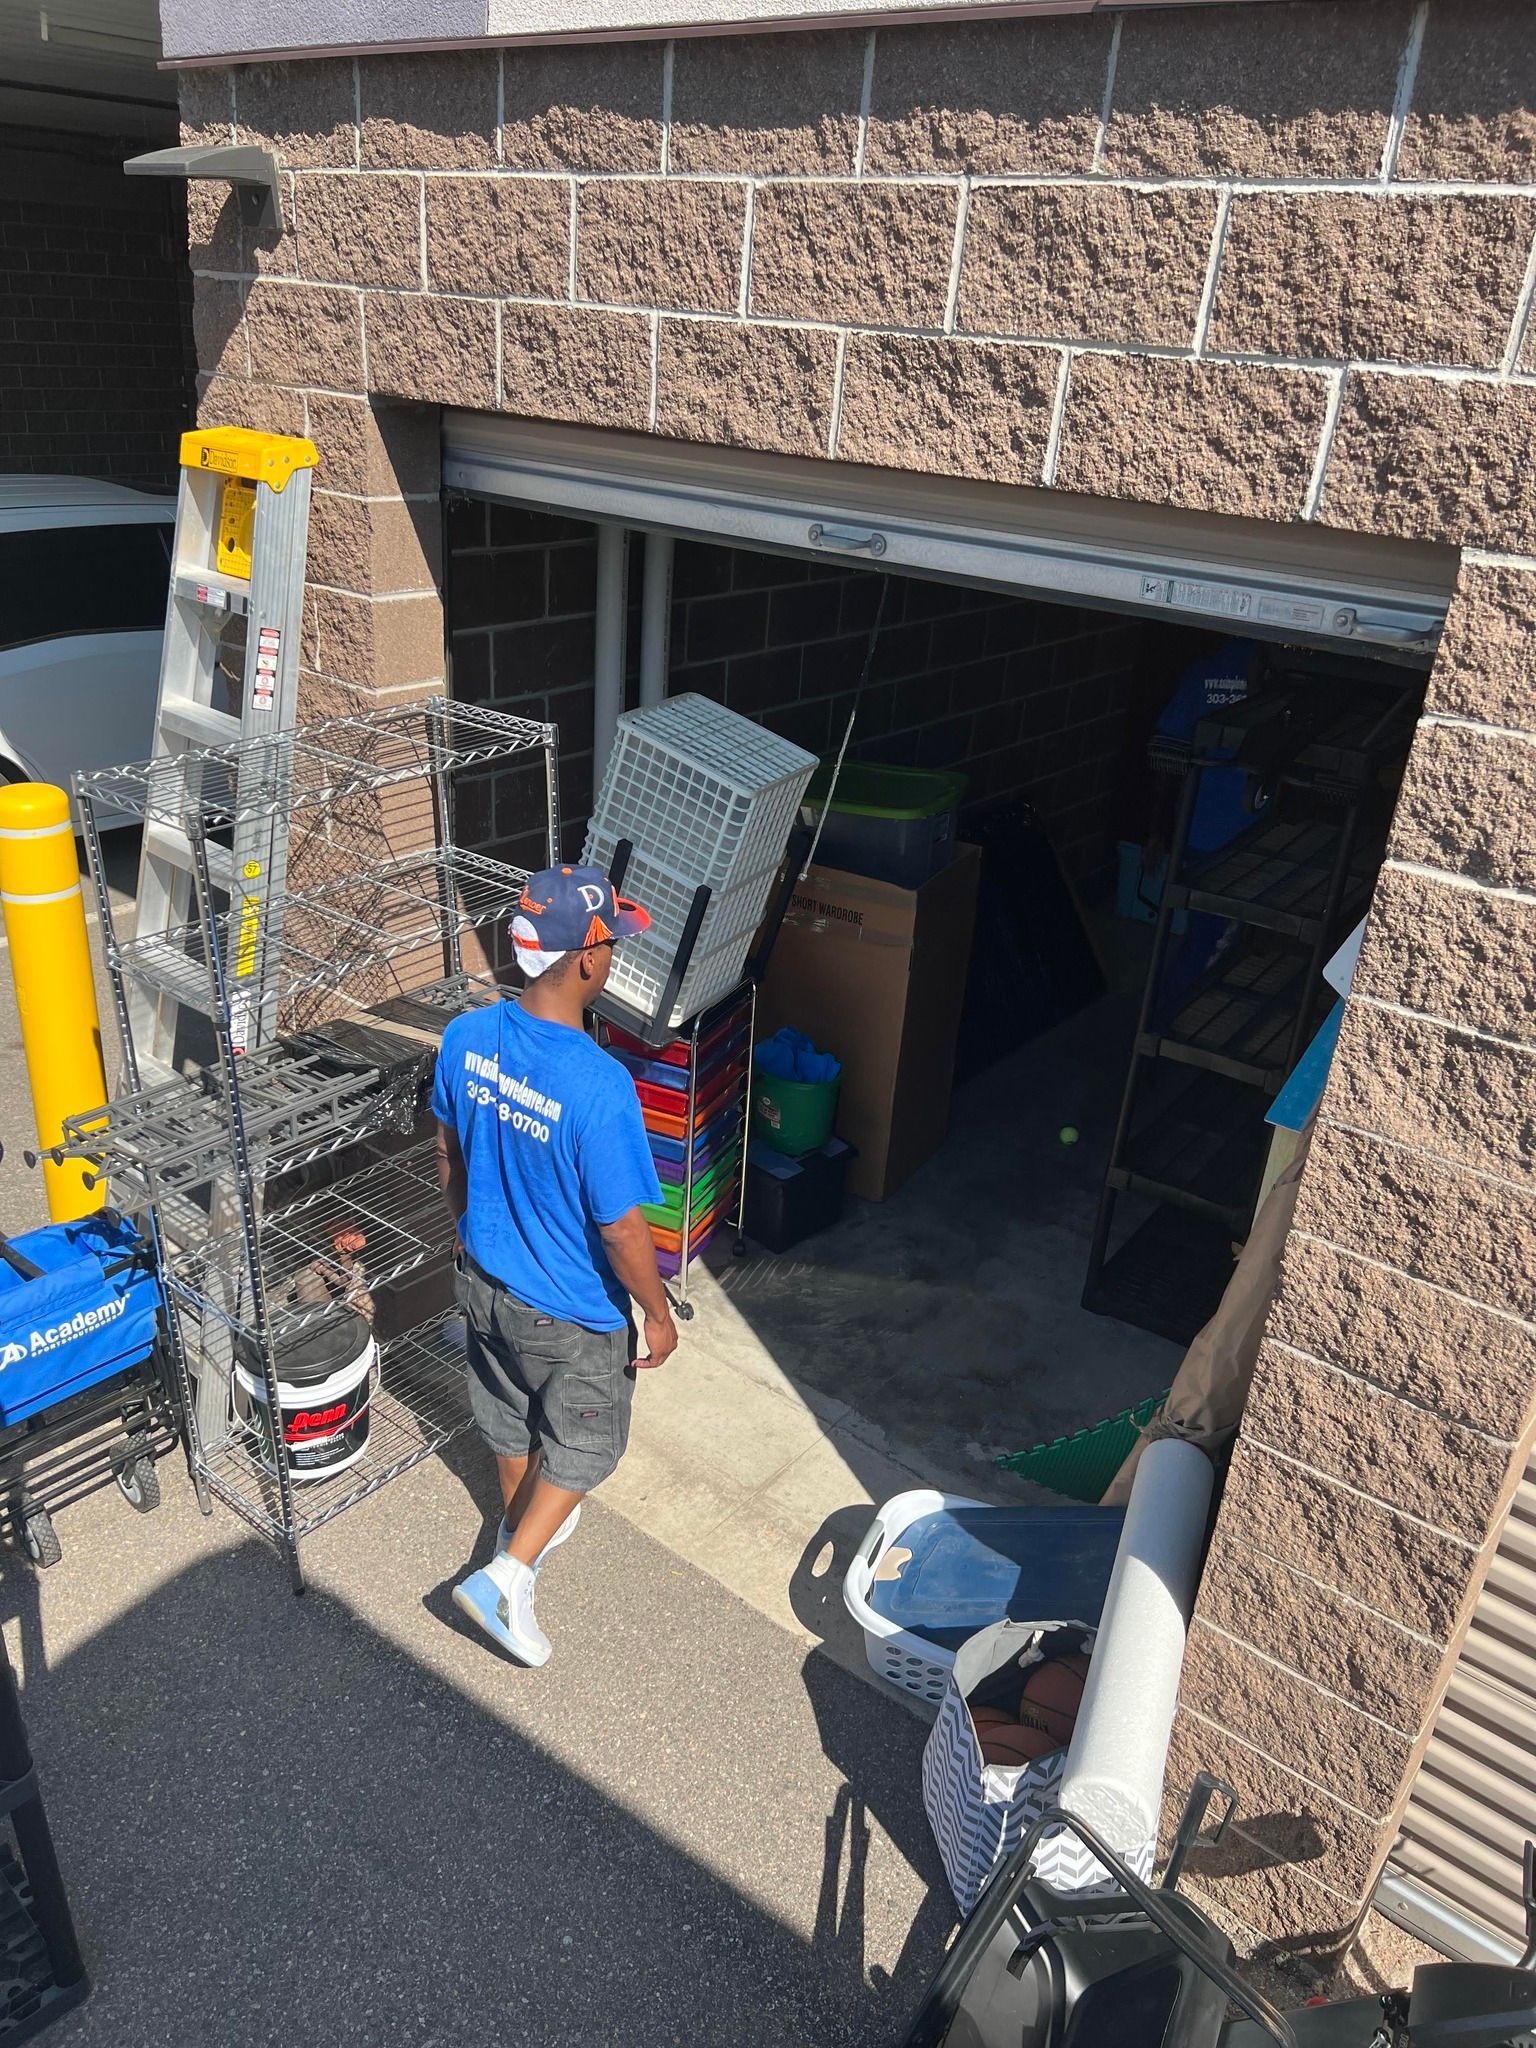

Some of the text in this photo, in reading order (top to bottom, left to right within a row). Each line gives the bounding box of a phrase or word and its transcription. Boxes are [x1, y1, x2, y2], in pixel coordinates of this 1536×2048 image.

[577, 884, 605, 912] D
[791, 894, 864, 926] SHORT WARDROBE
[30, 1296, 126, 1352] Academy
